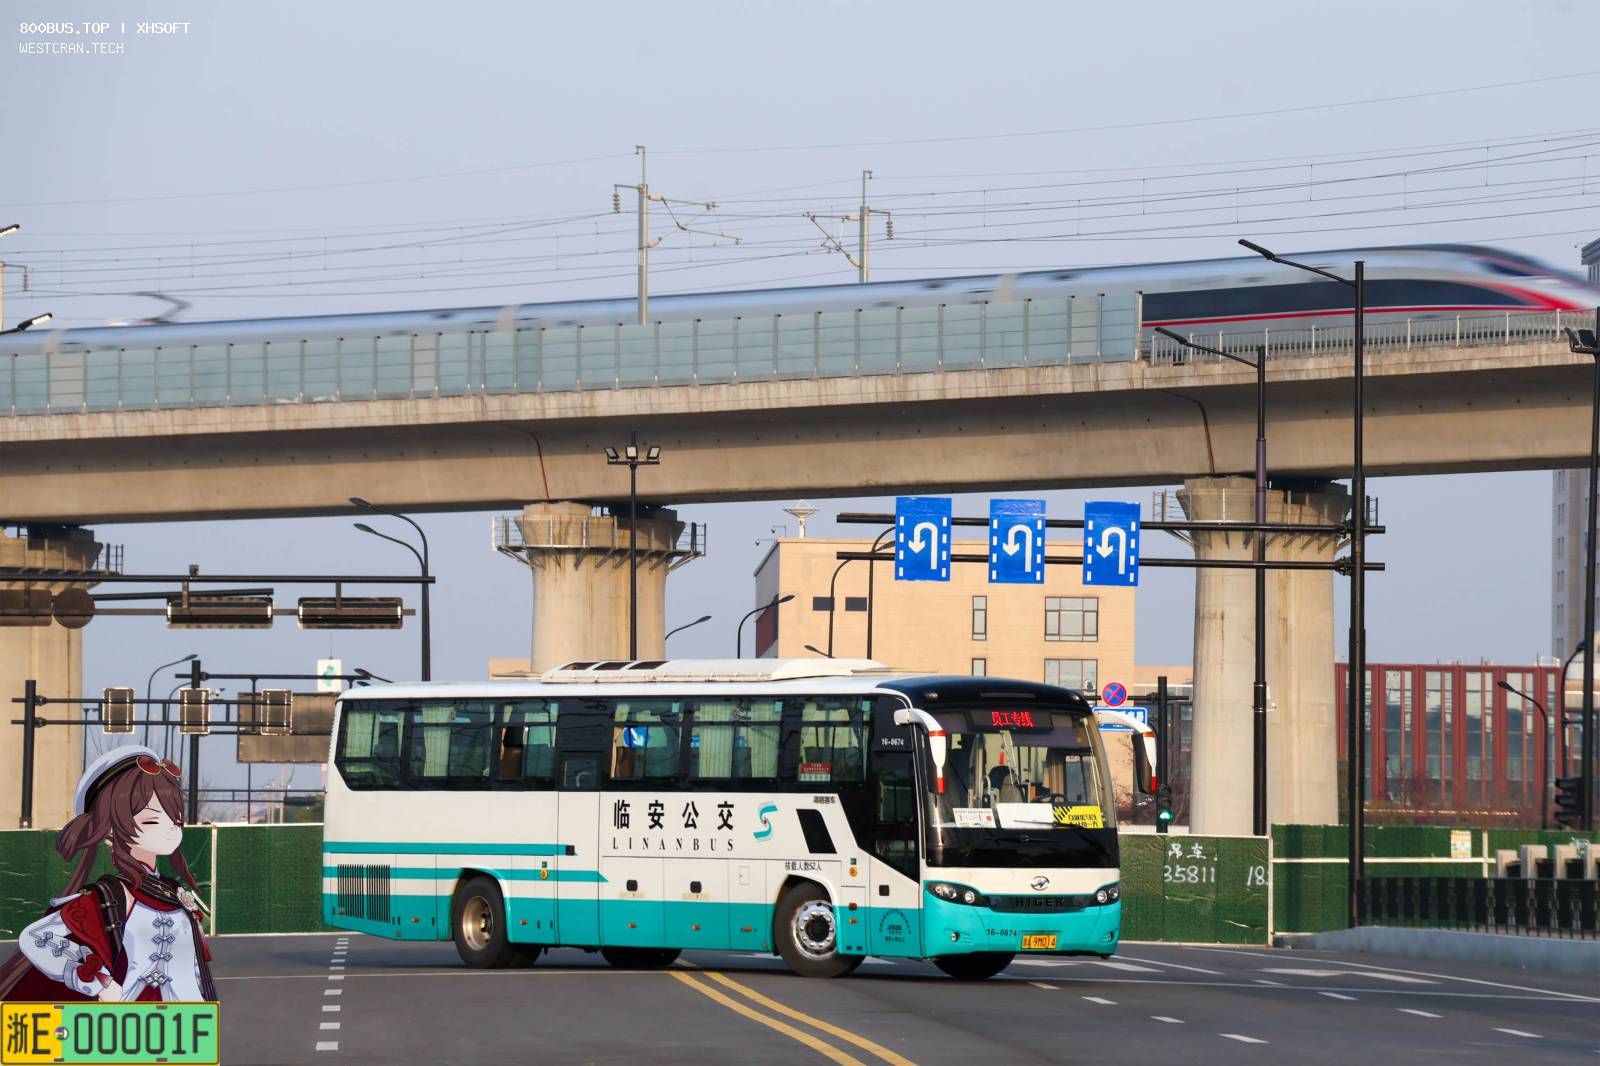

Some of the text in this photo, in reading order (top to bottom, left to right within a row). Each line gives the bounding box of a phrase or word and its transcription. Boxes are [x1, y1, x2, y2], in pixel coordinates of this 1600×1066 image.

[991, 711, 1035, 728] 员工专线
[881, 738, 905, 746] 16-0674
[613, 799, 735, 831] 临安公交
[612, 837, 734, 851] LINANBUS
[1163, 865, 1269, 887] 35811 18
[1015, 896, 1064, 907] HIGER
[986, 928, 1018, 937] 16-0674
